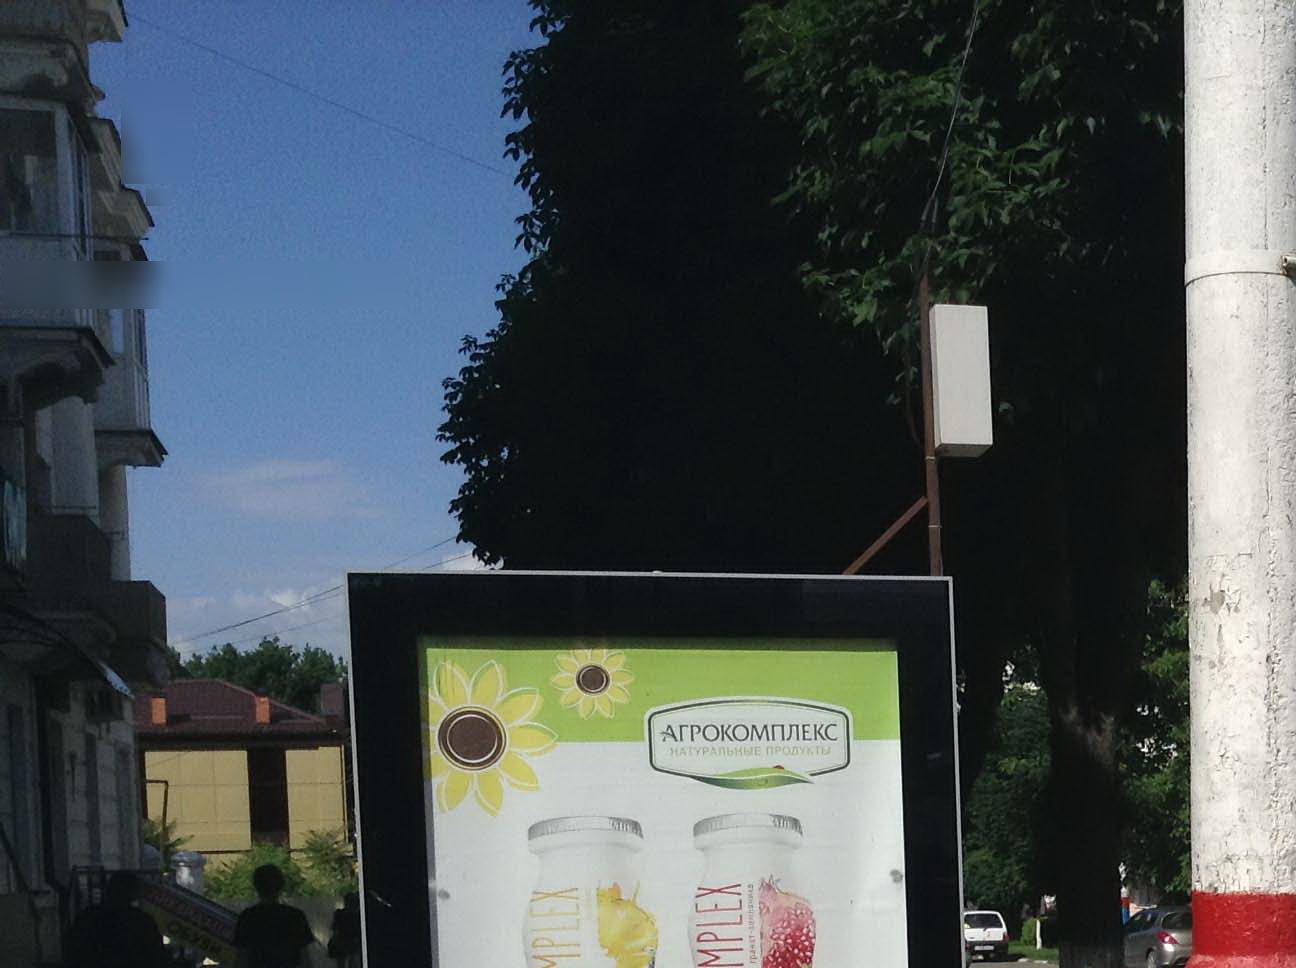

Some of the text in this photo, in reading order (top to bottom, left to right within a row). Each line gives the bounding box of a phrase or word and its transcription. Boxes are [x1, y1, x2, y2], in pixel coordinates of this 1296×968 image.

[660, 723, 838, 742] АГРОКОМПЛЕКС
[670, 744, 832, 758] НАТУРАЛЬНЫЕ ПРОДУКТЫ
